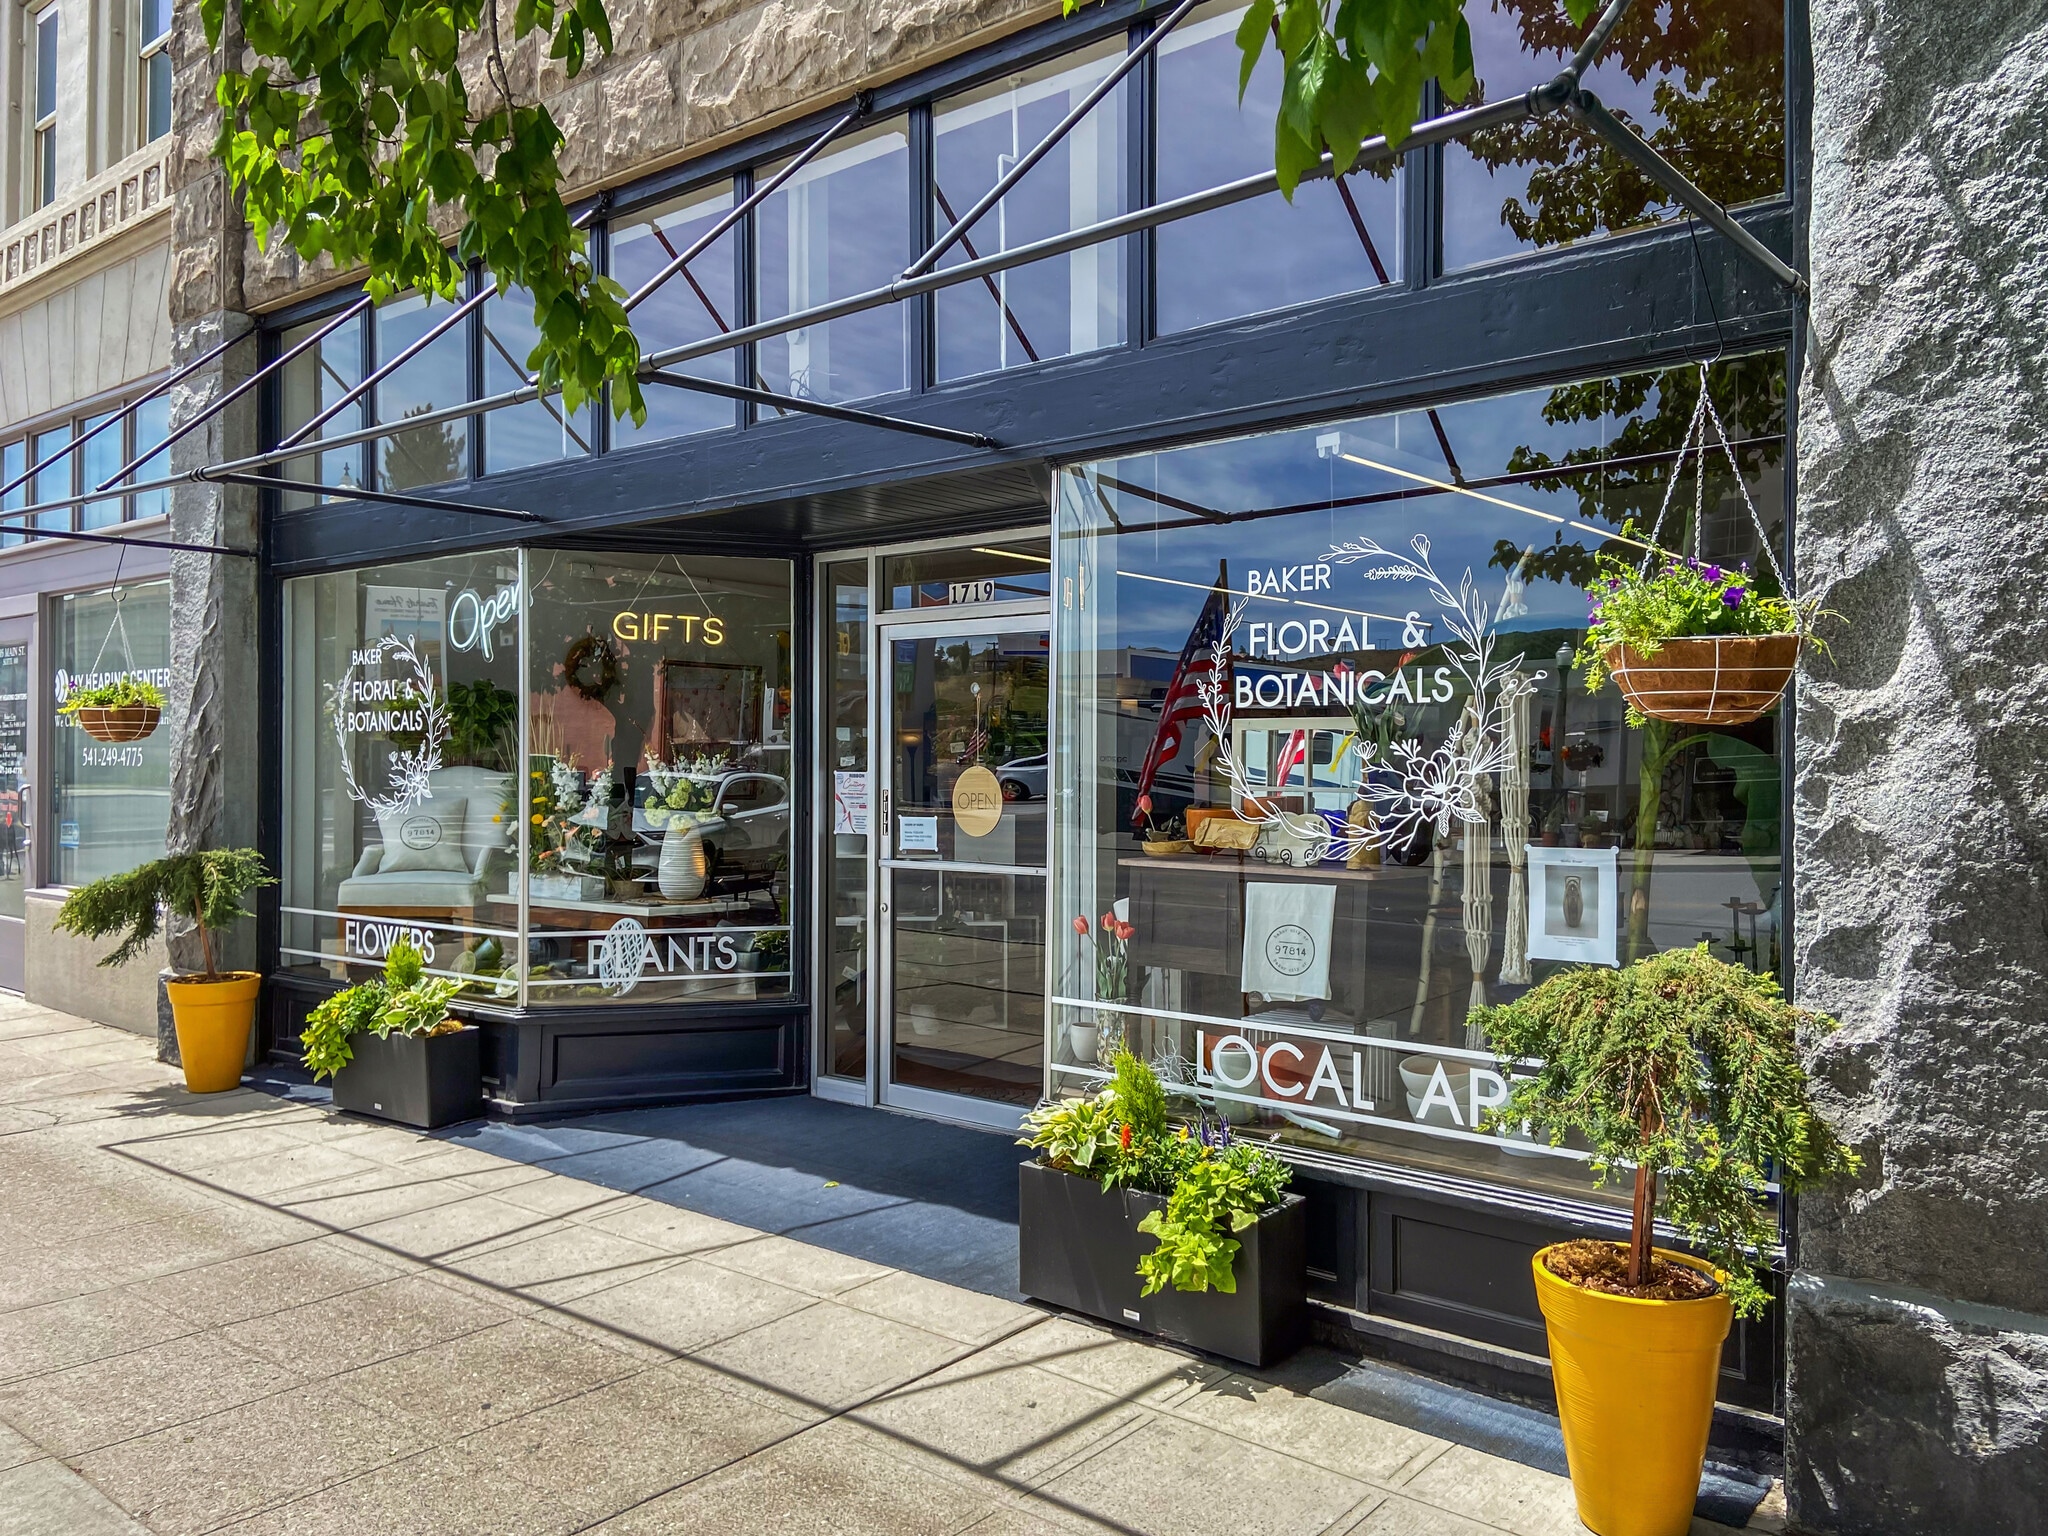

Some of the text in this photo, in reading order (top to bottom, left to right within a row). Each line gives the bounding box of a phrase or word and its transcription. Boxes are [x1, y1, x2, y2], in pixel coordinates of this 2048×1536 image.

[951, 581, 994, 604] 1719
[1247, 563, 1331, 596] BAKER
[450, 582, 521, 660] Open
[612, 611, 725, 646] GIFTS
[1248, 610, 1428, 657] FLORAL &
[352, 647, 382, 666] BAKER
[353, 677, 414, 702] FLORAL &
[1235, 666, 1455, 709] BOTANICALS
[347, 709, 423, 732] BOTANICALS
[82, 746, 144, 767] 541-249-4775
[957, 792, 997, 810] OPEN
[345, 920, 436, 964] FLOWERS
[587, 930, 738, 976] PLANTS
[1275, 945, 1306, 957] 97814
[1196, 1029, 1375, 1112] LOCAL
